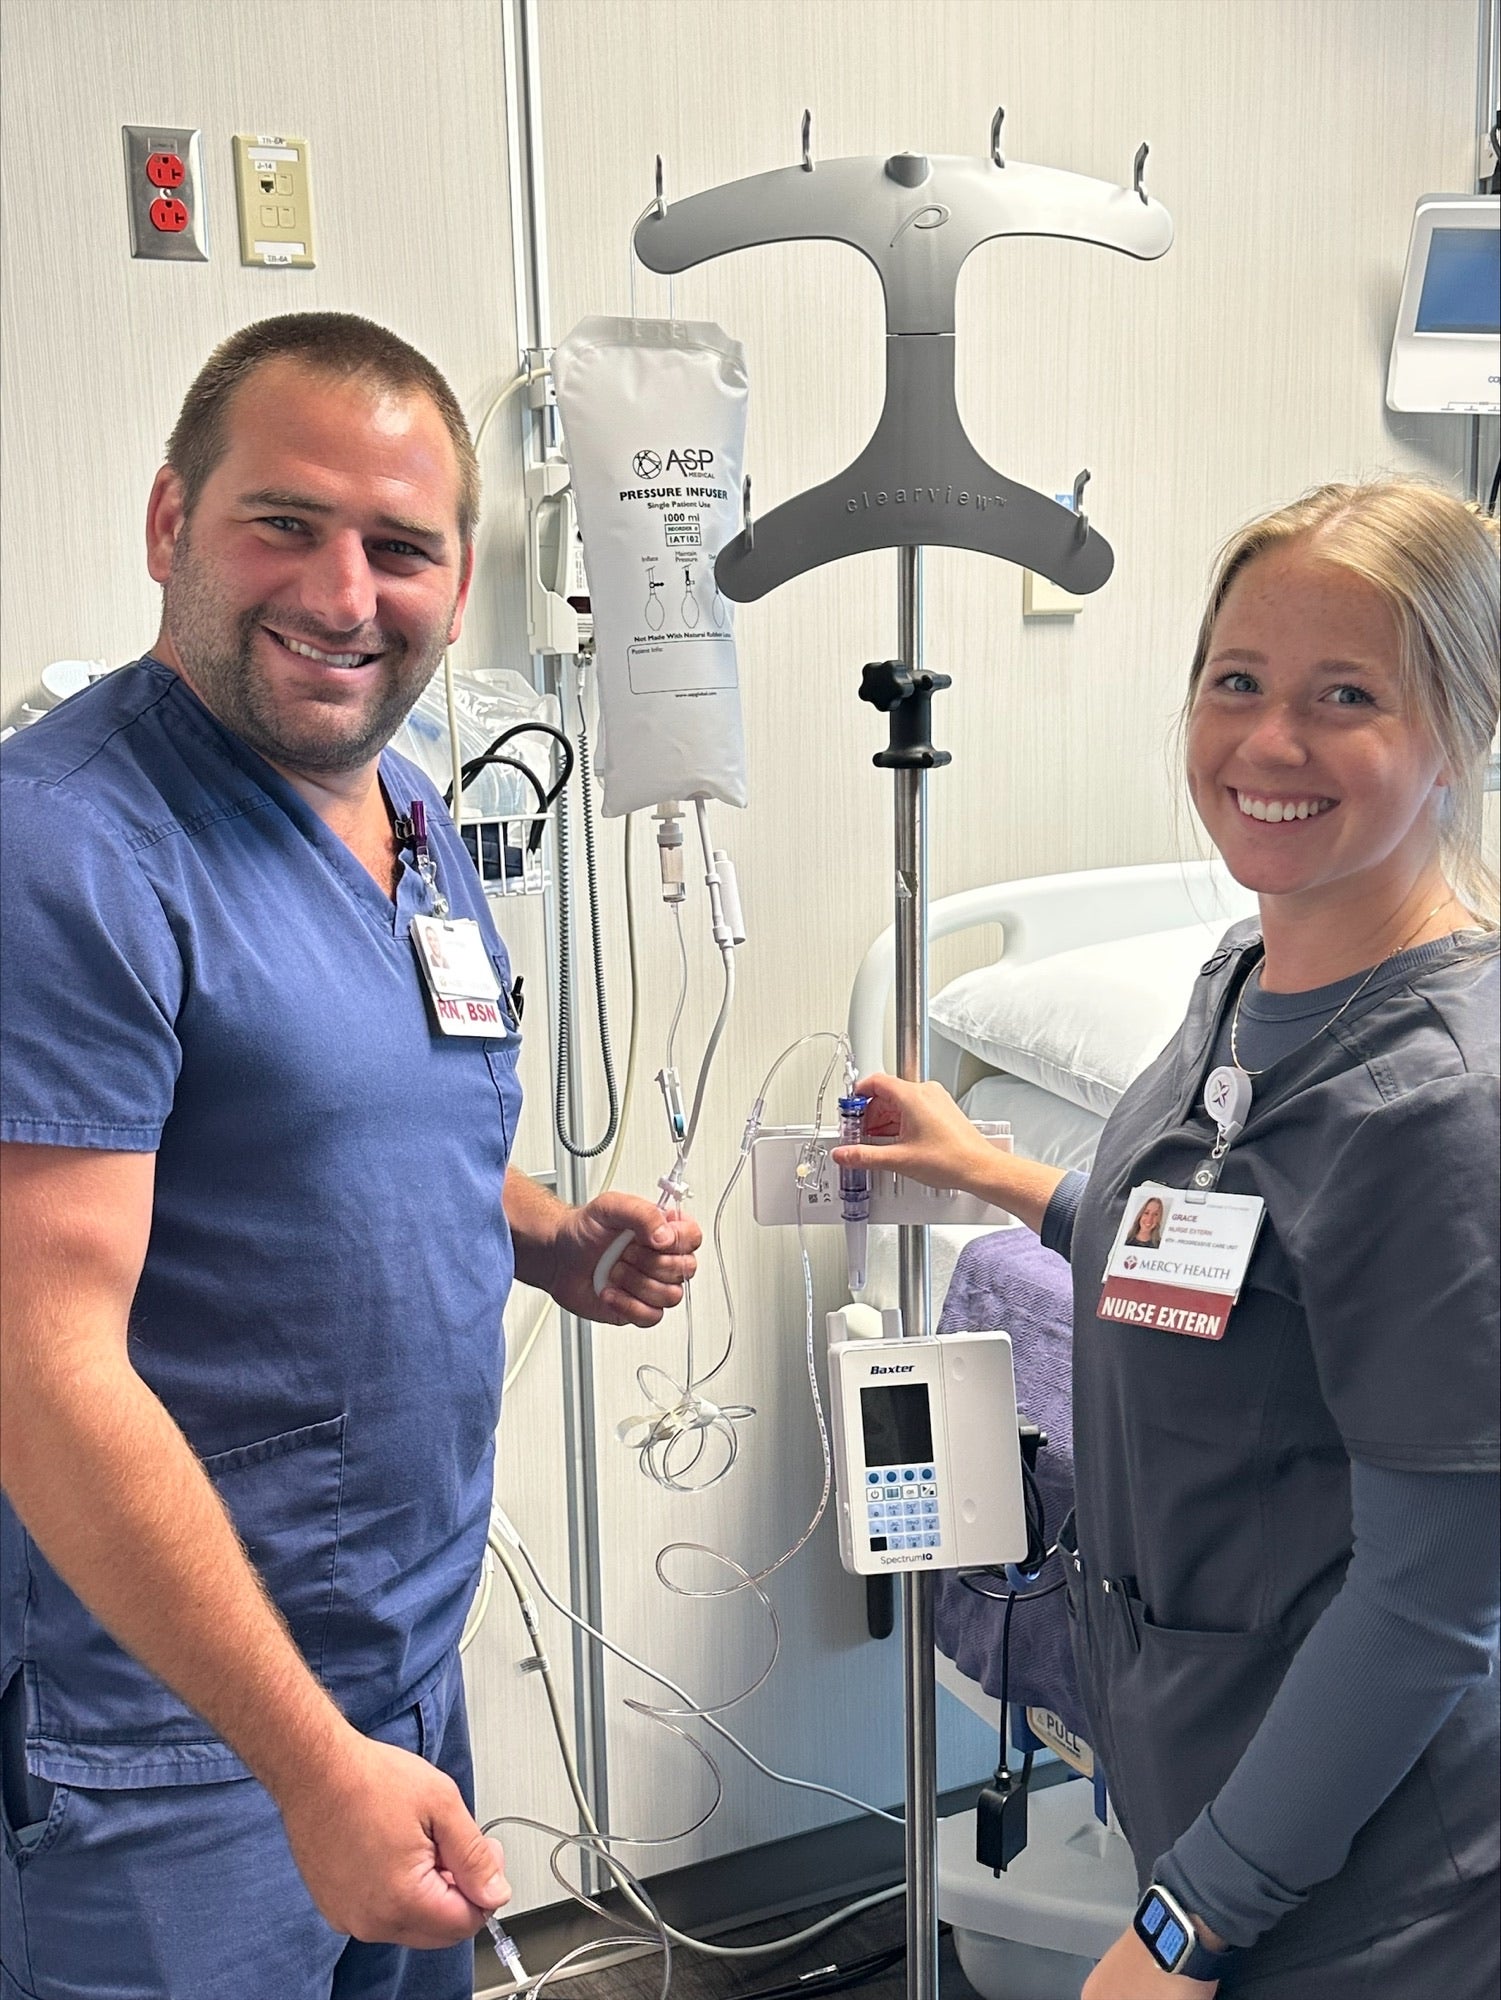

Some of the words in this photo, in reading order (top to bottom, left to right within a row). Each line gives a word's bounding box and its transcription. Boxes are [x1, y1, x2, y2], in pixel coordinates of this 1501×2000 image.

[665, 448, 714, 478] ASP
[619, 487, 682, 501] PRESSURE
[686, 487, 729, 500] INFUSER
[647, 501, 670, 510] Single
[699, 501, 711, 509] Use
[664, 513, 685, 522] 1000
[688, 513, 700, 522] ml
[466, 1002, 497, 1023] BSN
[1171, 1213, 1199, 1223] GRACE
[1168, 1226, 1188, 1234] NURSE
[1189, 1228, 1213, 1236] EXTERN
[1139, 1259, 1182, 1275] MERCY
[1184, 1265, 1231, 1280] HEALTH
[1101, 1296, 1155, 1324] NURSE
[1156, 1306, 1222, 1336] EXTERN
[870, 1363, 915, 1375] Baxter
[1046, 1713, 1080, 1752] PULL
